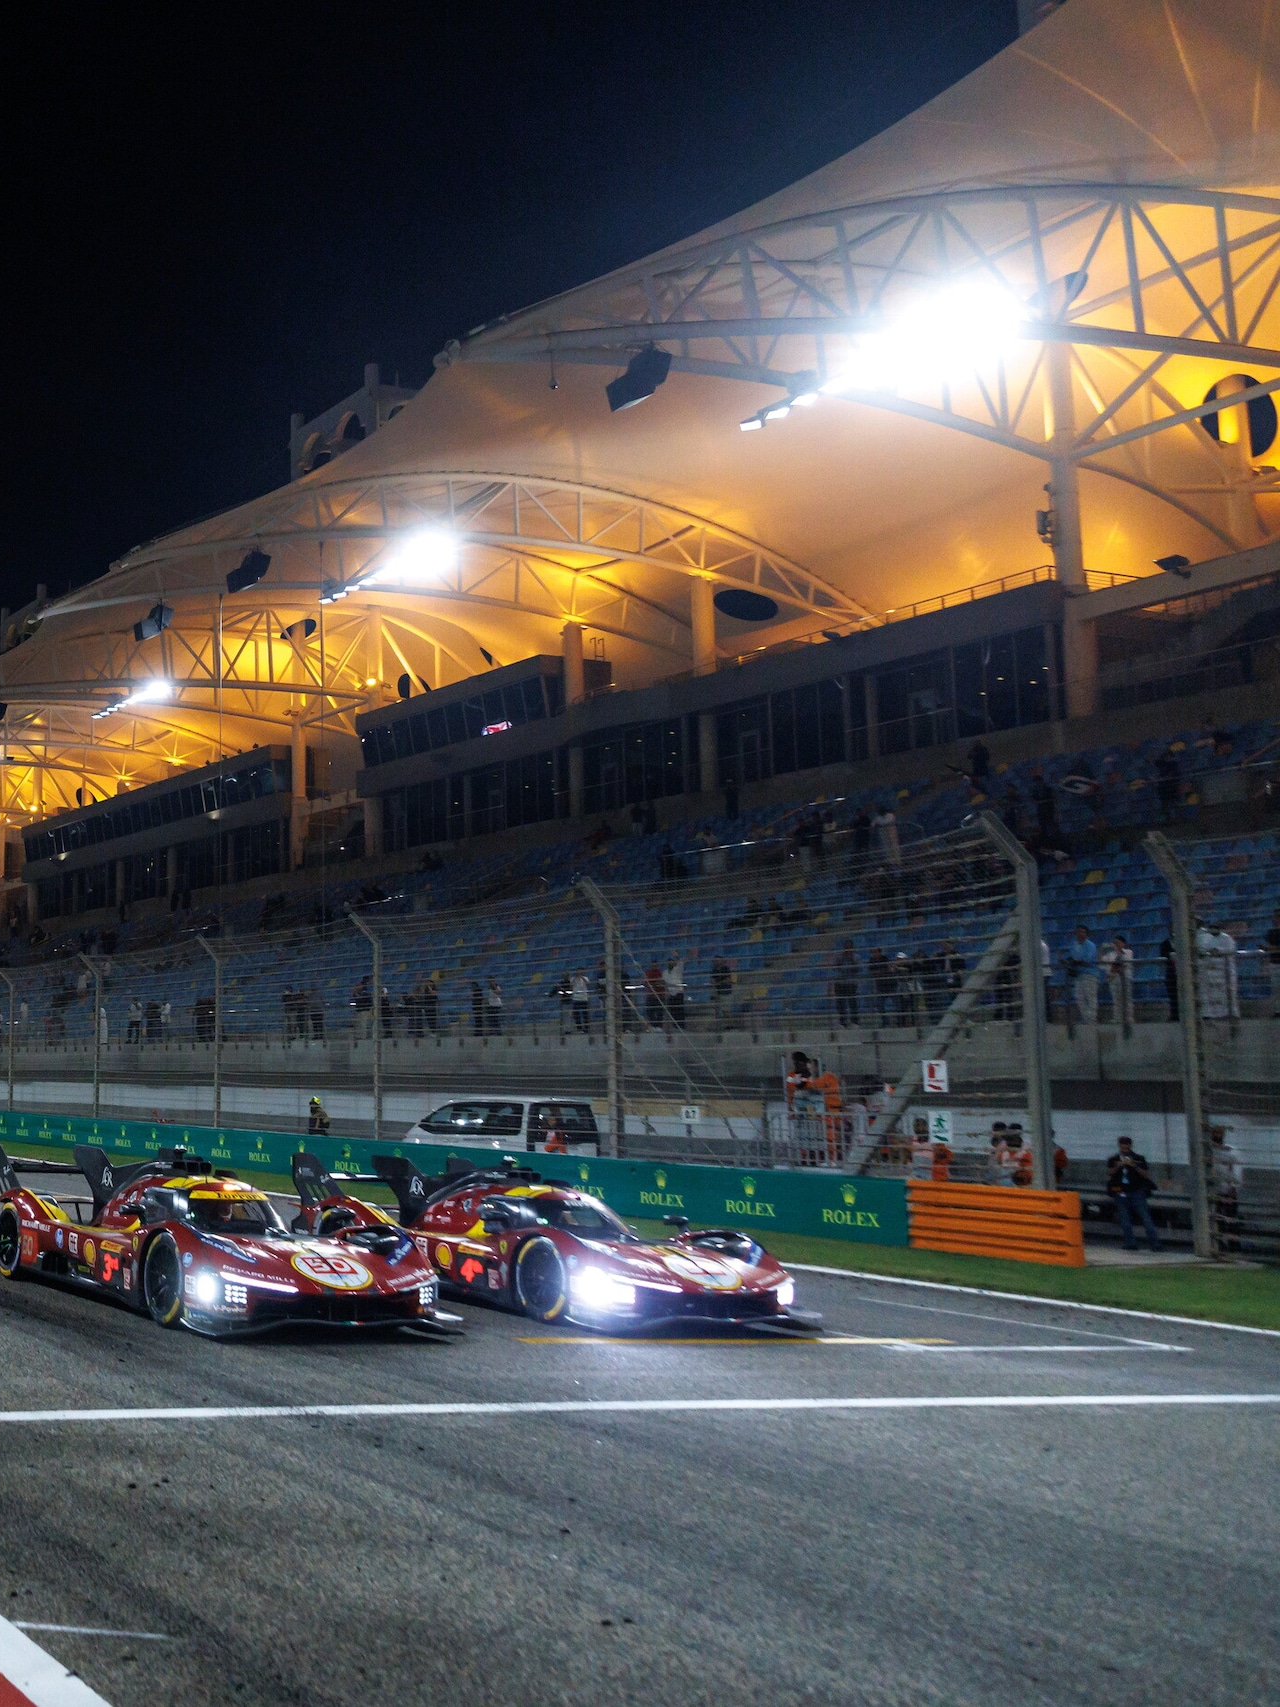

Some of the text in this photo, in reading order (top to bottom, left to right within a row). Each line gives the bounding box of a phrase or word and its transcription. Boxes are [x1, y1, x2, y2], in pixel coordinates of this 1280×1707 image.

[62, 1133, 77, 1142] ROLEX
[87, 1136, 103, 1145] ROLEX
[115, 1138, 131, 1148] ROLEX
[211, 1148, 231, 1159] ROLEX
[248, 1152, 271, 1163] ROLEX
[334, 1160, 361, 1173] ROLEX
[639, 1190, 684, 1208] ROLEX
[725, 1199, 776, 1217] ROLEX
[822, 1208, 880, 1228] ROLEX
[23, 1235, 34, 1256] 50
[308, 1258, 353, 1274] 50
[223, 1264, 296, 1284] RICHARD MILLE
[213, 1304, 247, 1313] V-Power
